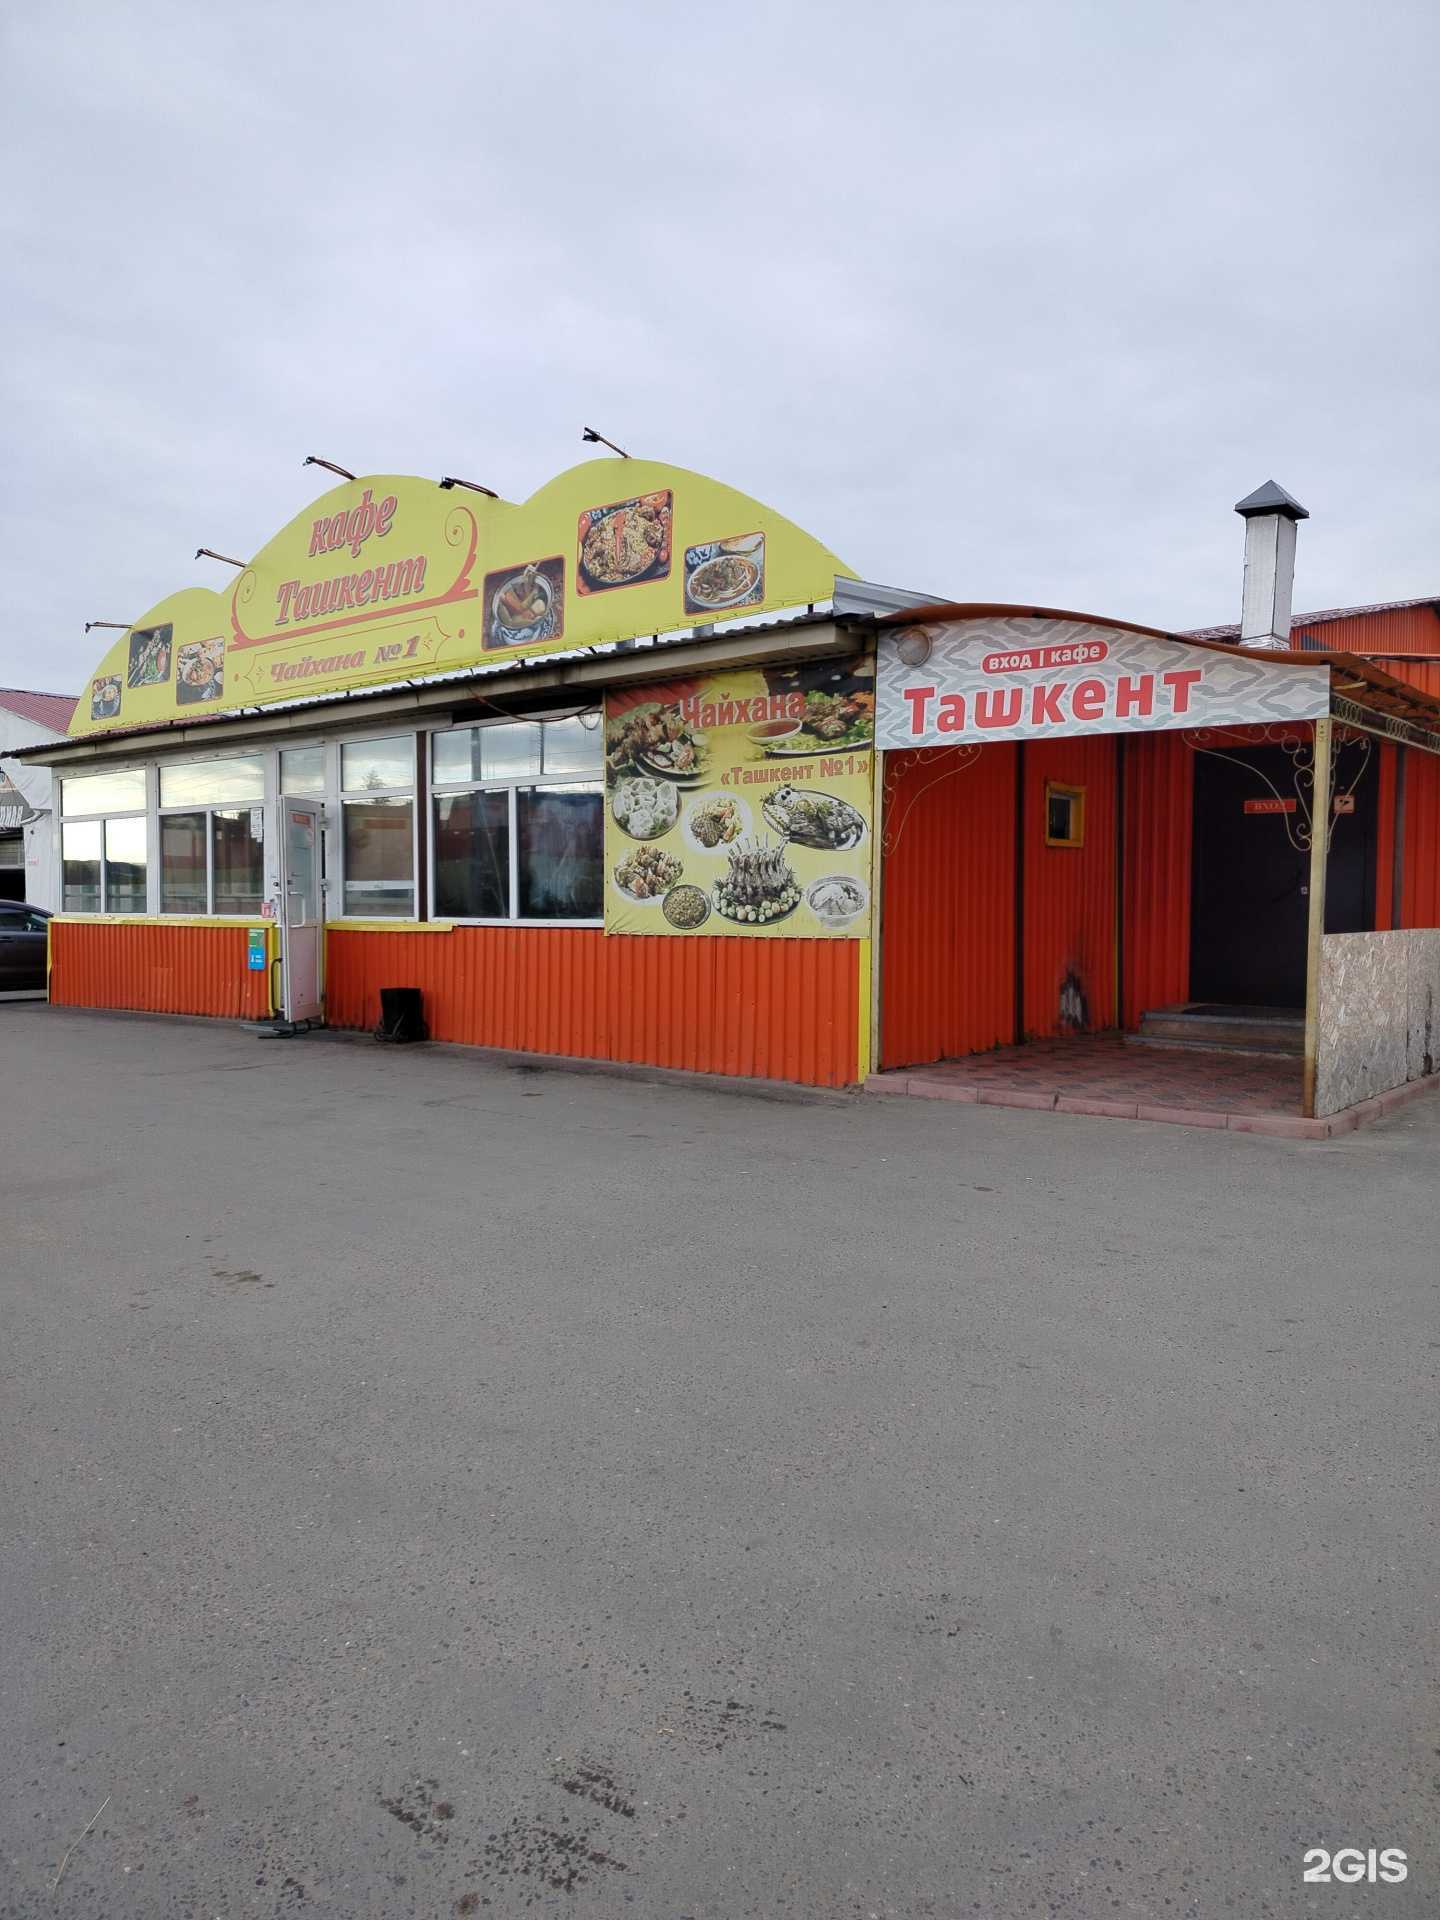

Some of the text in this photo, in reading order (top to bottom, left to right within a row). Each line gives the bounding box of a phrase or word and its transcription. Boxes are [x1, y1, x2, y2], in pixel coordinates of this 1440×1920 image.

[308, 488, 397, 558] кафе
[274, 554, 427, 625] Ташкент
[270, 648, 366, 683] Чайхана
[987, 642, 1101, 671] вход кафе
[679, 690, 807, 729] Чайхана
[902, 668, 1203, 735] Ташкент
[720, 764, 815, 786] «Ташкент
